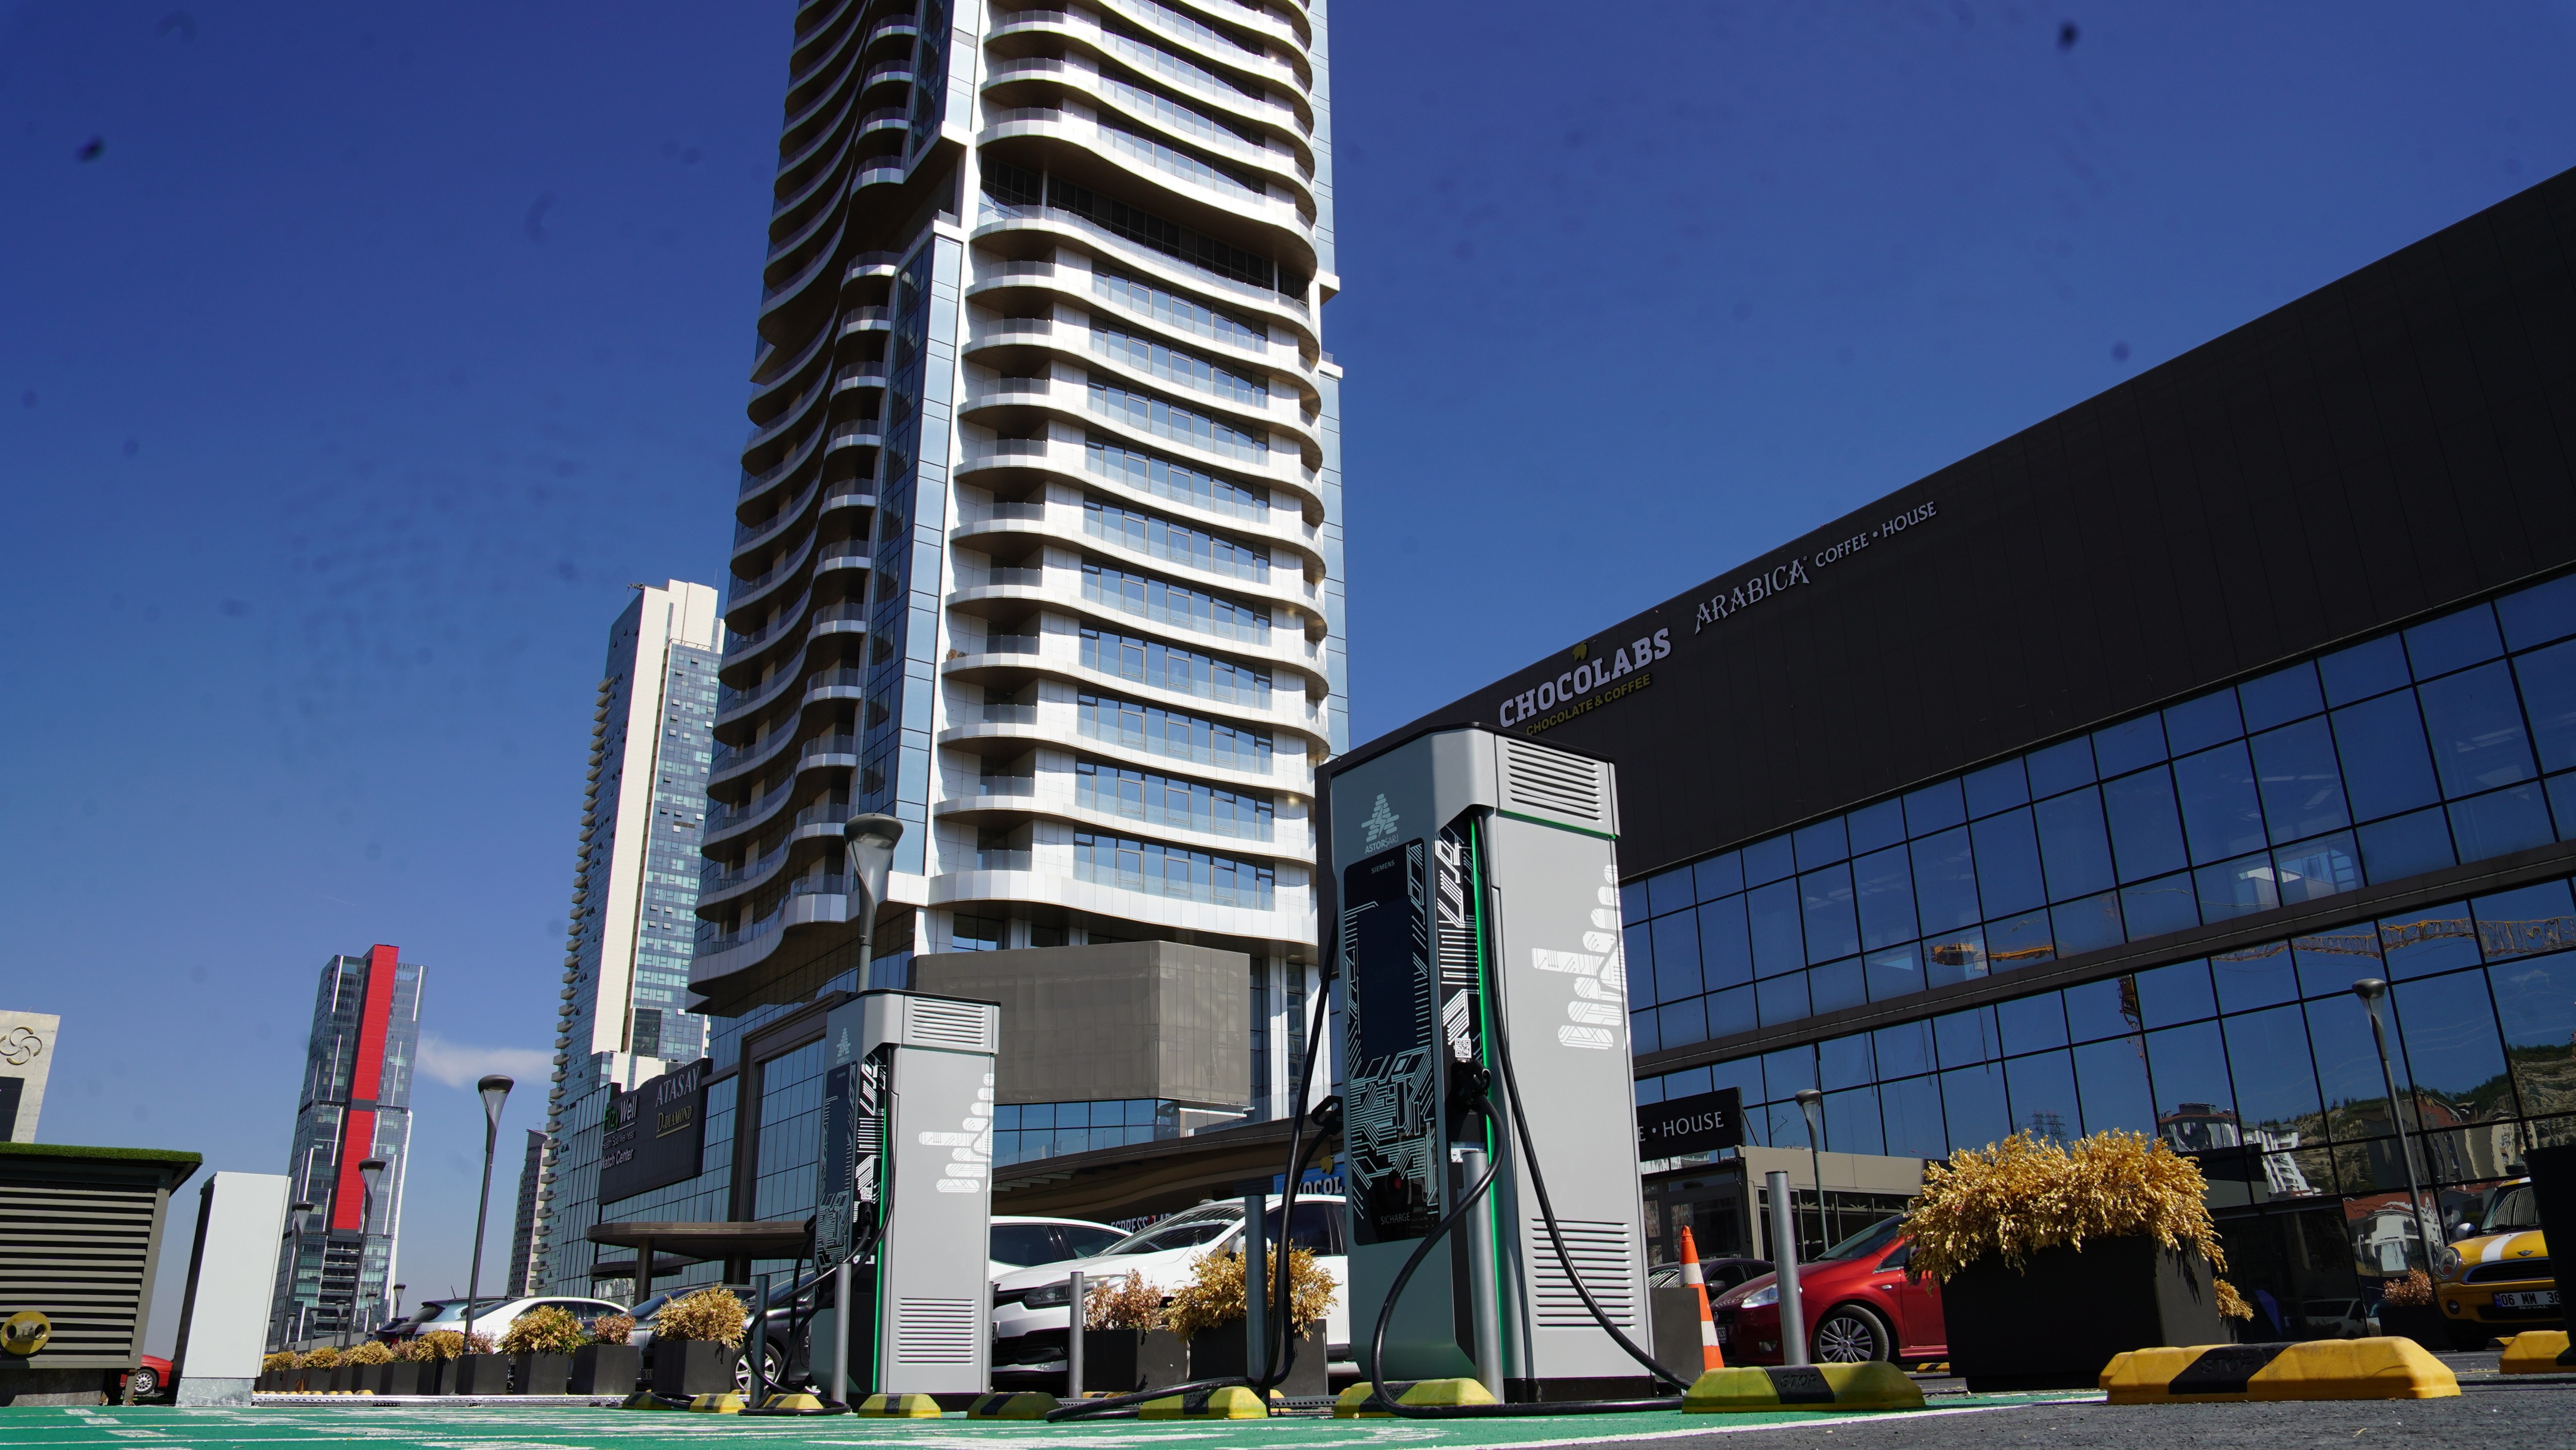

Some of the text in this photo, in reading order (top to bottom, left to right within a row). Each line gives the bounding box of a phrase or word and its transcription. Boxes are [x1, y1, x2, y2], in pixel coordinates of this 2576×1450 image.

[1695, 501, 1937, 635] ARABICA COFFEE HOUSE
[1499, 627, 1671, 728] CHOCOLABS
[1526, 673, 1651, 736] CHOCOLATE & COFFEE
[1371, 860, 1395, 874] SIEMENS
[655, 1066, 700, 1108] ATASAY
[1662, 1111, 1723, 1137] HOUSE
[616, 1148, 633, 1164] Center
[1380, 1212, 1410, 1225] SICHARGE
[2501, 1294, 2515, 1306] 06
[2200, 1357, 2254, 1373] STOP
[1780, 1374, 1818, 1388] STOP
